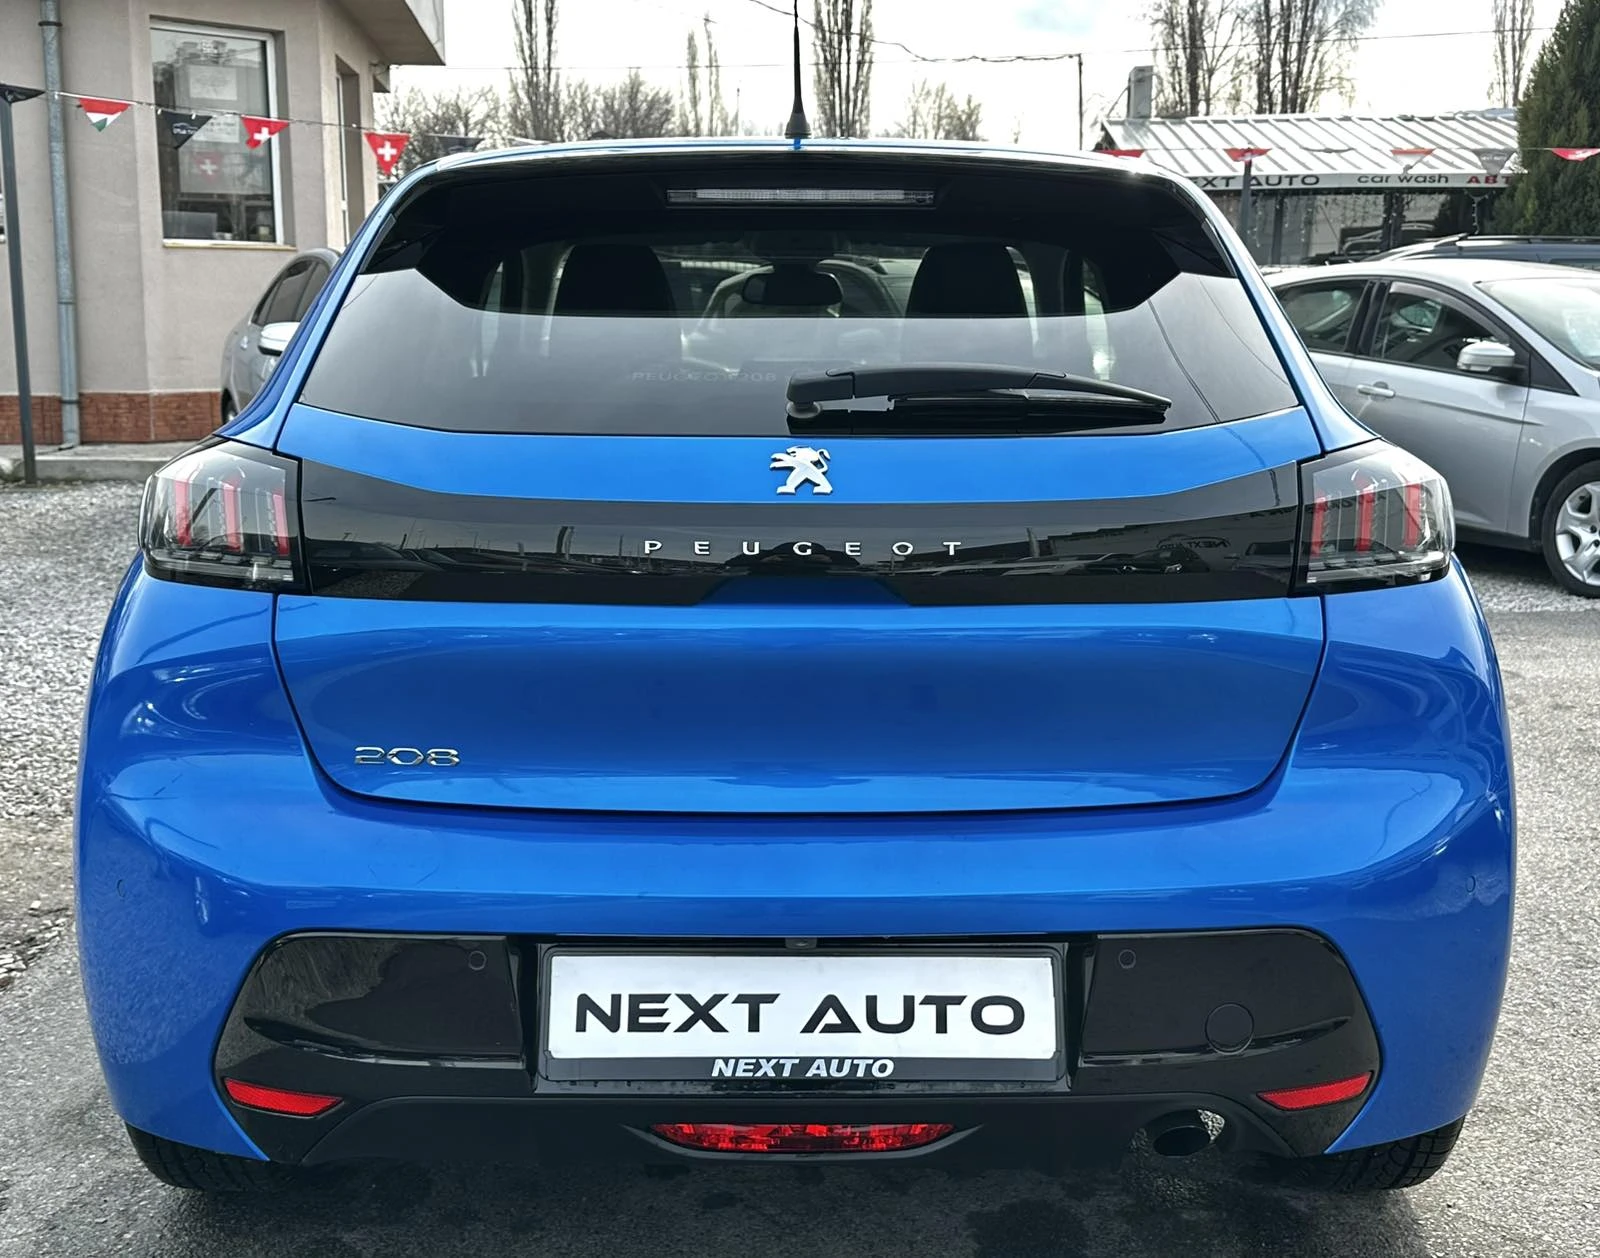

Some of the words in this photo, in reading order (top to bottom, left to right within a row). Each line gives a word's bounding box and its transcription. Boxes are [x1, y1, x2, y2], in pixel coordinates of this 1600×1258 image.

[1250, 175, 1320, 187] AUTO
[1357, 174, 1391, 184] car
[1398, 173, 1449, 184] wash
[644, 540, 962, 556] PEUGEOT
[355, 746, 460, 766] 208
[575, 992, 781, 1034] NEXT
[800, 993, 1026, 1035] AUTO
[711, 1058, 800, 1078] NEXT
[805, 1058, 895, 1078] AUTO
